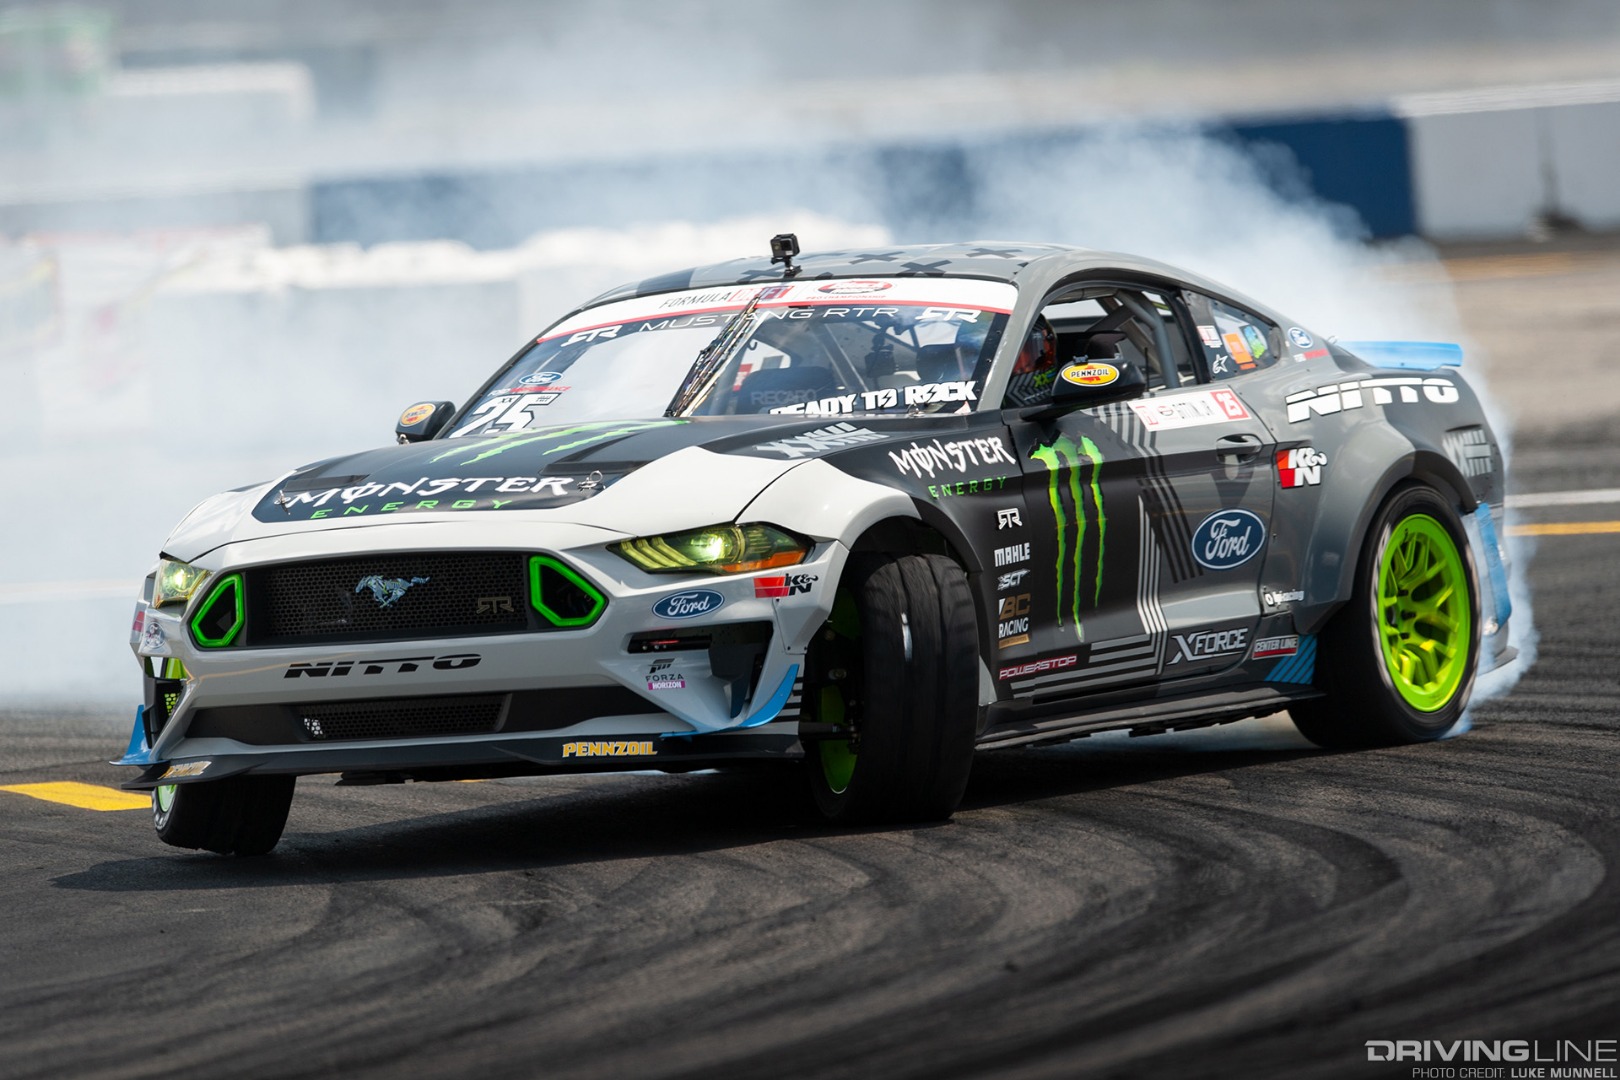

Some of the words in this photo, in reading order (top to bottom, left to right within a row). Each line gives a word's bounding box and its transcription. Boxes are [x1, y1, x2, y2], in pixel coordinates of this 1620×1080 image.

[660, 291, 731, 308] FORMULA
[639, 309, 811, 332] MUSTANG
[823, 307, 899, 317] RTR
[1070, 369, 1110, 378] PENNZOIL
[861, 388, 898, 410] TO
[903, 381, 978, 405] ROCK
[1285, 378, 1459, 424] NITTO
[448, 393, 561, 438] 25
[887, 437, 1017, 478] MONSTER
[285, 477, 574, 508] MONSTER
[928, 476, 1007, 499] ENERGY
[310, 500, 512, 519] ENERGY
[1205, 519, 1252, 560] Ford
[994, 542, 1031, 567] MAHLE
[667, 593, 711, 616] Ford
[999, 617, 1029, 638] RACING
[284, 653, 482, 678] NITTO
[645, 673, 684, 682] FORZA
[652, 681, 682, 690] HORIZON
[562, 741, 658, 758] PENNZOIL
